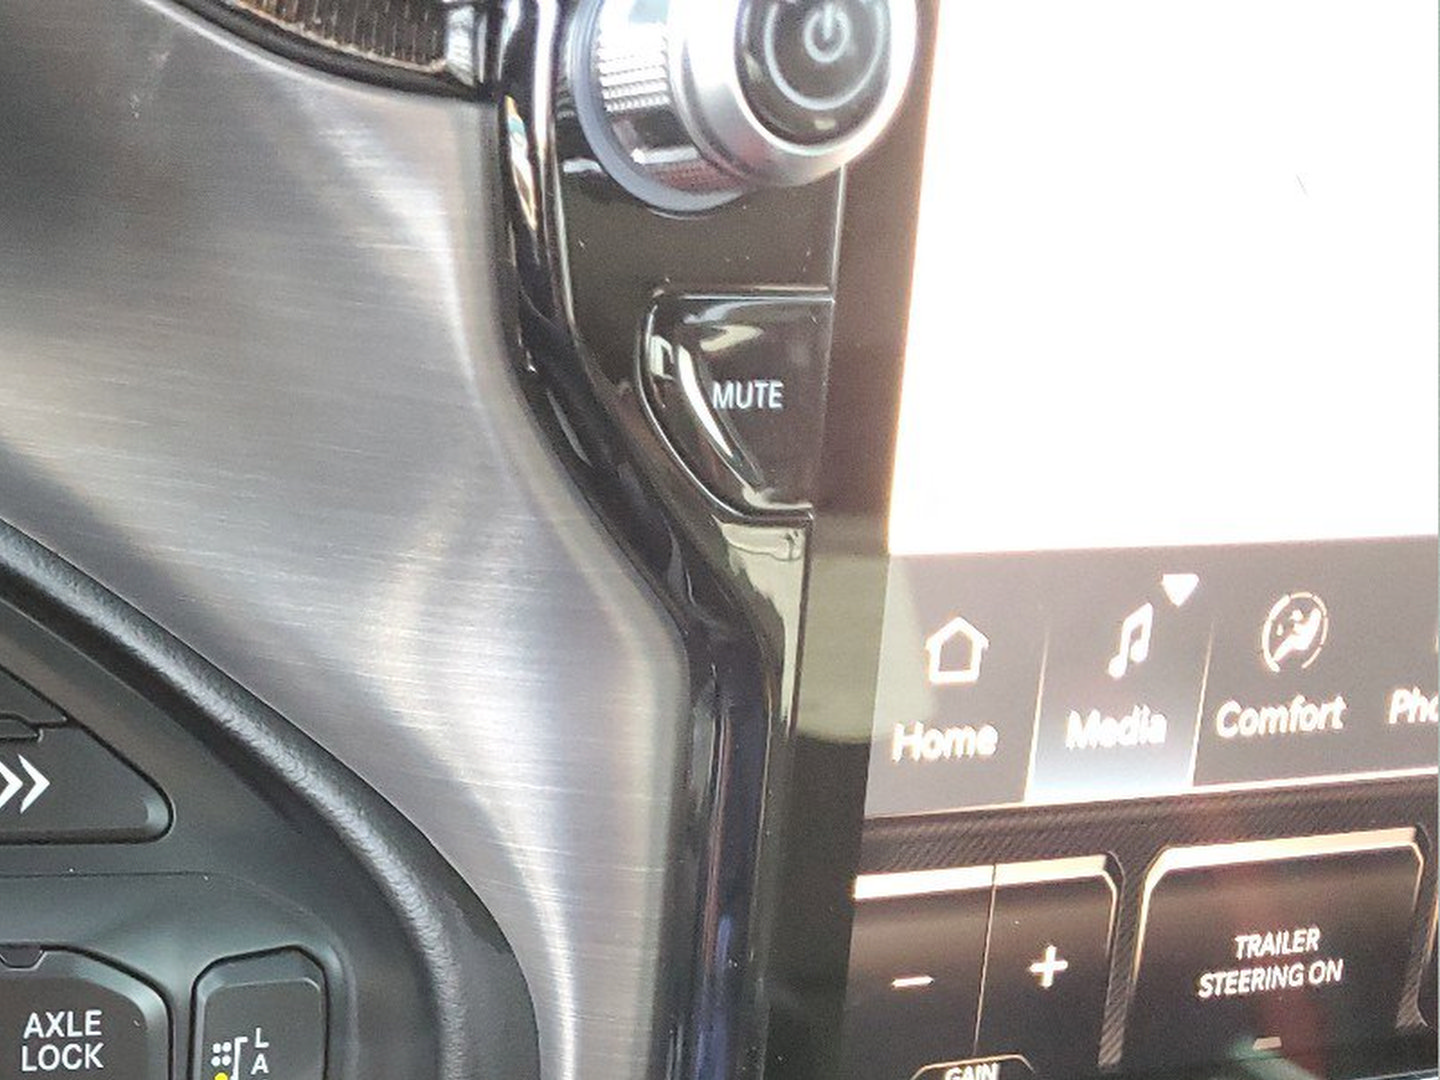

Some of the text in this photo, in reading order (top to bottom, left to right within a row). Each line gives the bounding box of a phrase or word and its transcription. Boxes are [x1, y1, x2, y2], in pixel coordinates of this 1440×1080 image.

[712, 379, 784, 409] MUTE
[1065, 704, 1169, 749] Media
[1216, 694, 1347, 738] Comfort
[891, 721, 999, 763] Home
[1234, 927, 1321, 960] TRAILER
[1197, 958, 1344, 999] STEERING ON
[23, 1009, 103, 1039] AXLE
[21, 1042, 104, 1072] LOCK
